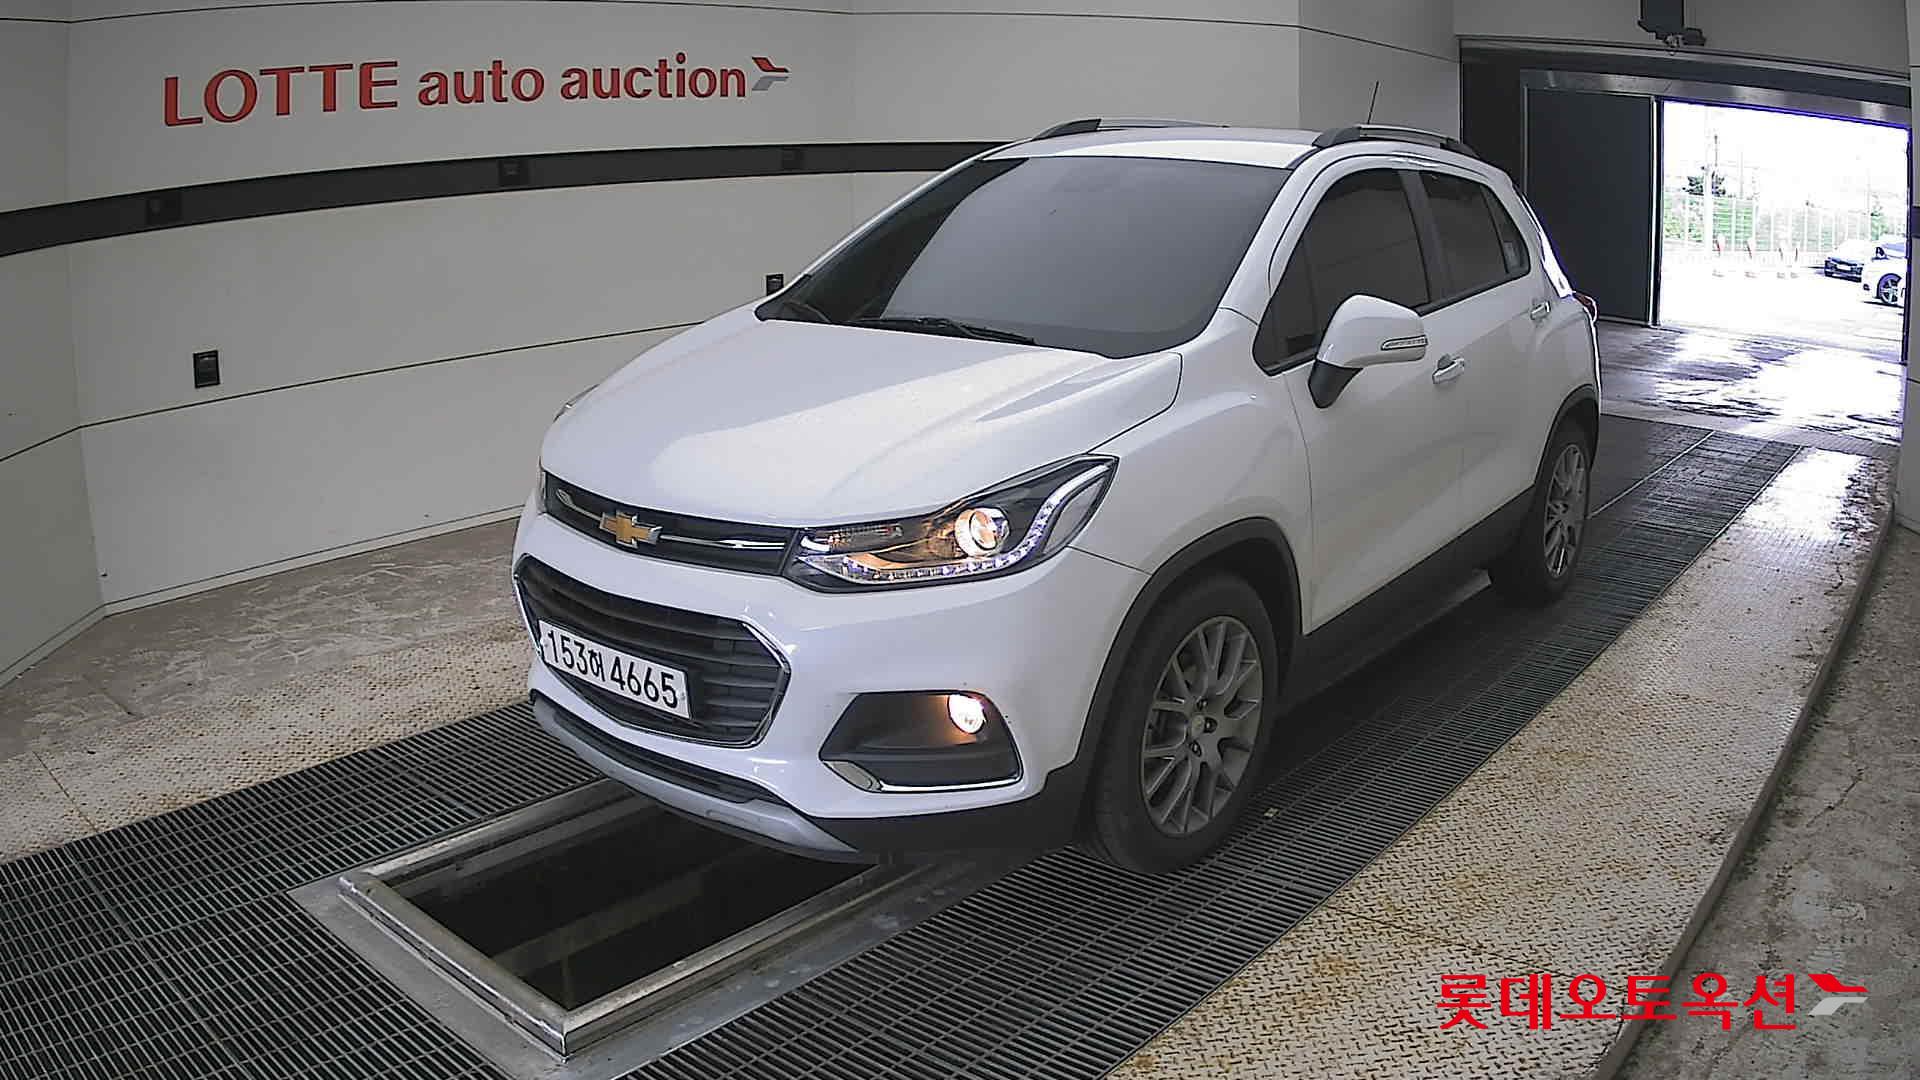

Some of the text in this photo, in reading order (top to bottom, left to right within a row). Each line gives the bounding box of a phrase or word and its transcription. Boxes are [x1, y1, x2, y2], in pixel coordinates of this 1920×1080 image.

[164, 52, 747, 127] LOTTE auto auction
